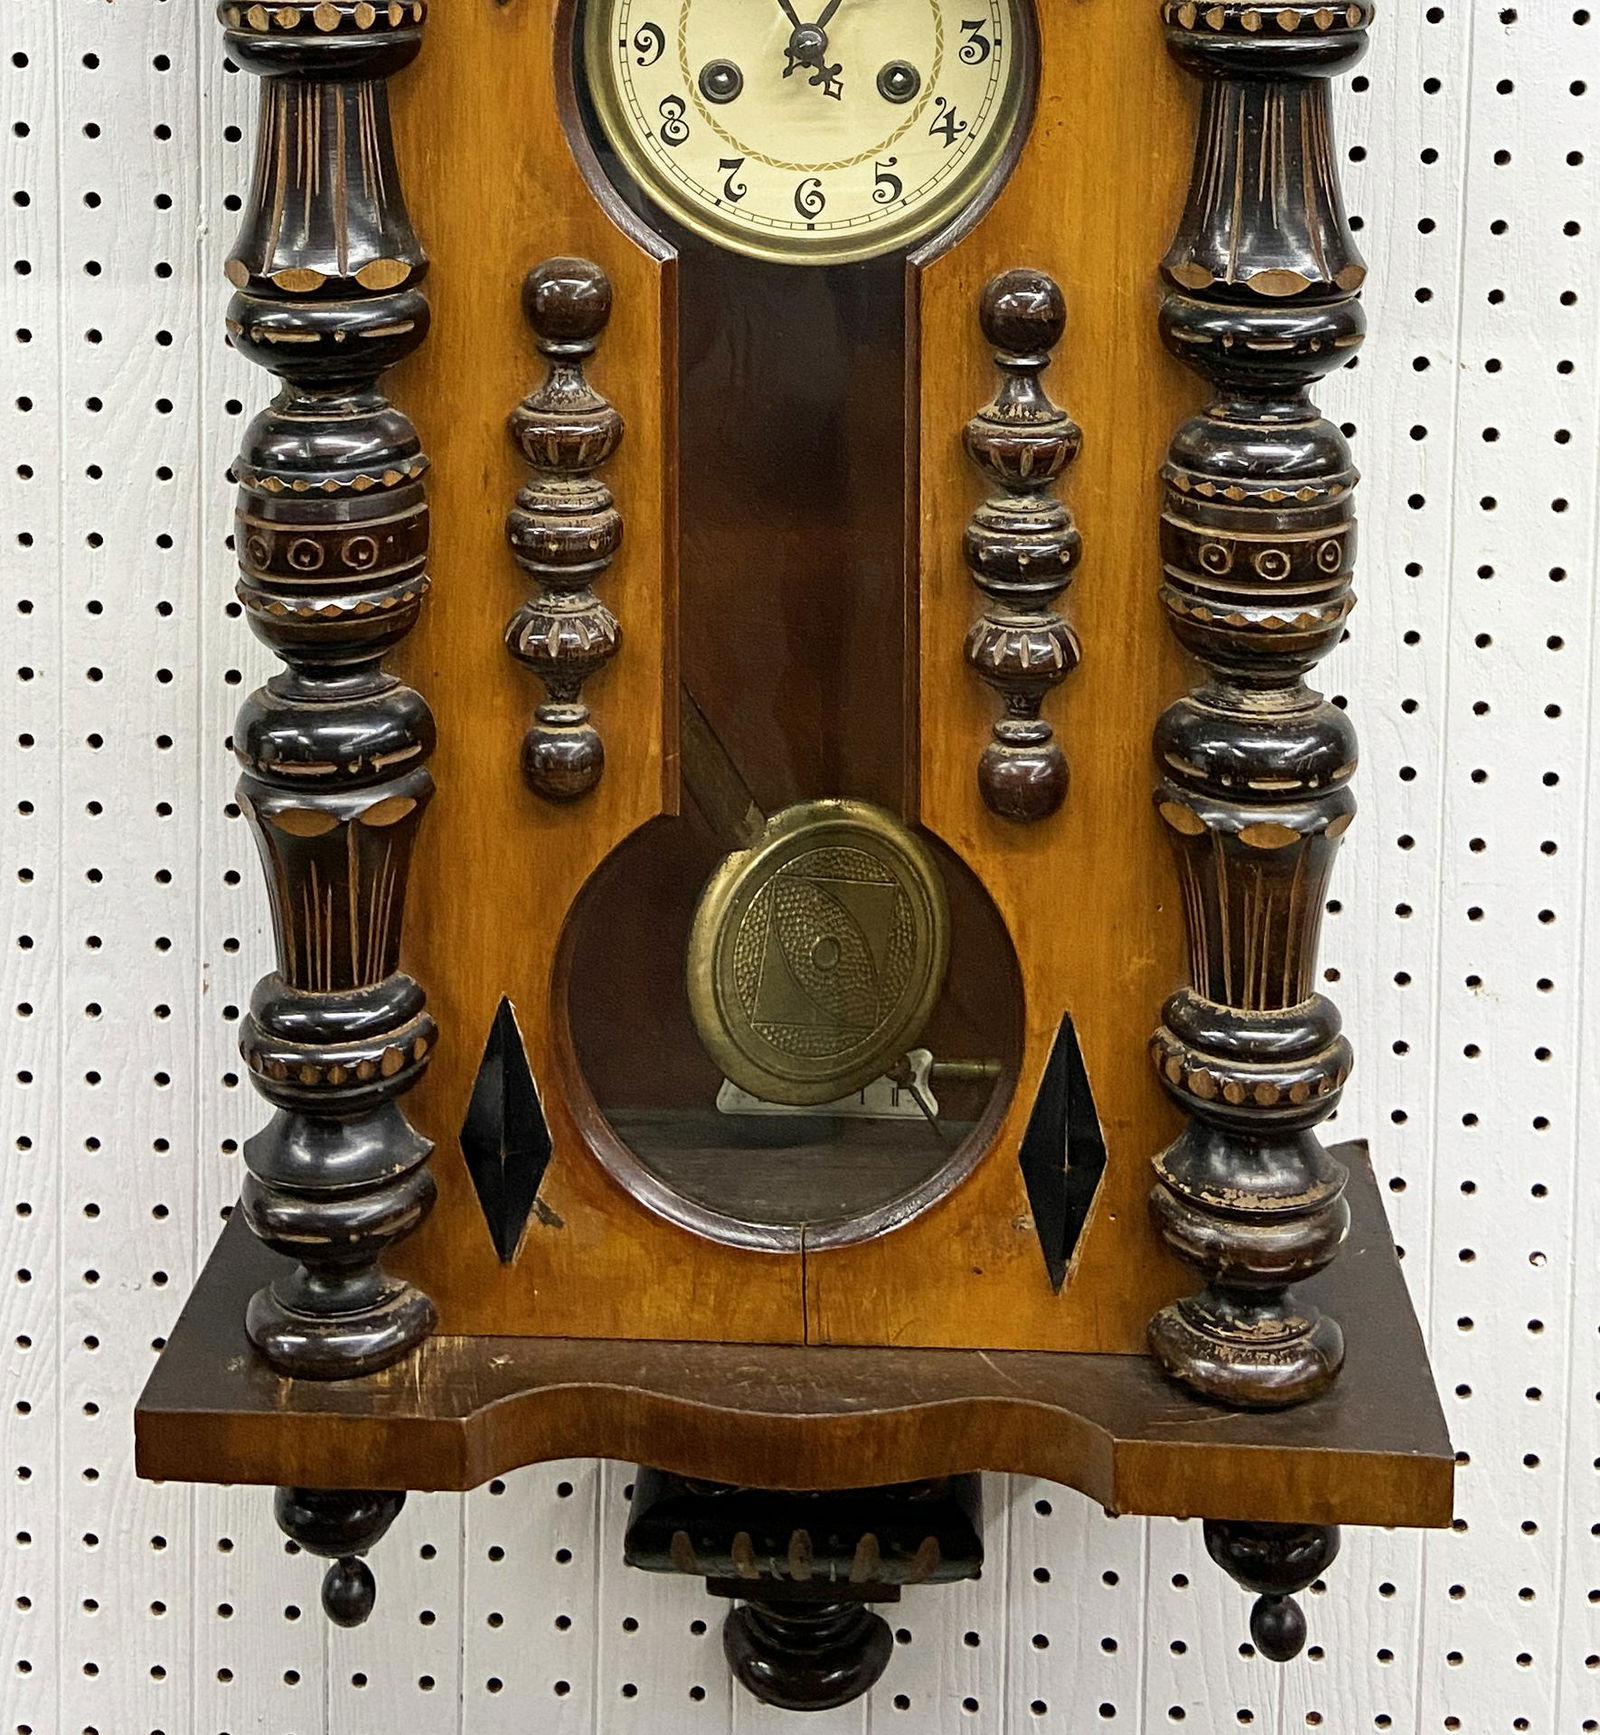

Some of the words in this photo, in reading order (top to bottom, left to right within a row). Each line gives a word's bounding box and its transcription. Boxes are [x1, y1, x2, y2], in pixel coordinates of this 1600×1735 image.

[633, 22, 666, 67] 9
[959, 19, 991, 65] 3
[658, 94, 690, 148] 8
[929, 97, 967, 149] 4
[717, 157, 748, 203] 7
[794, 177, 826, 220] 6
[872, 157, 902, 205] 5
